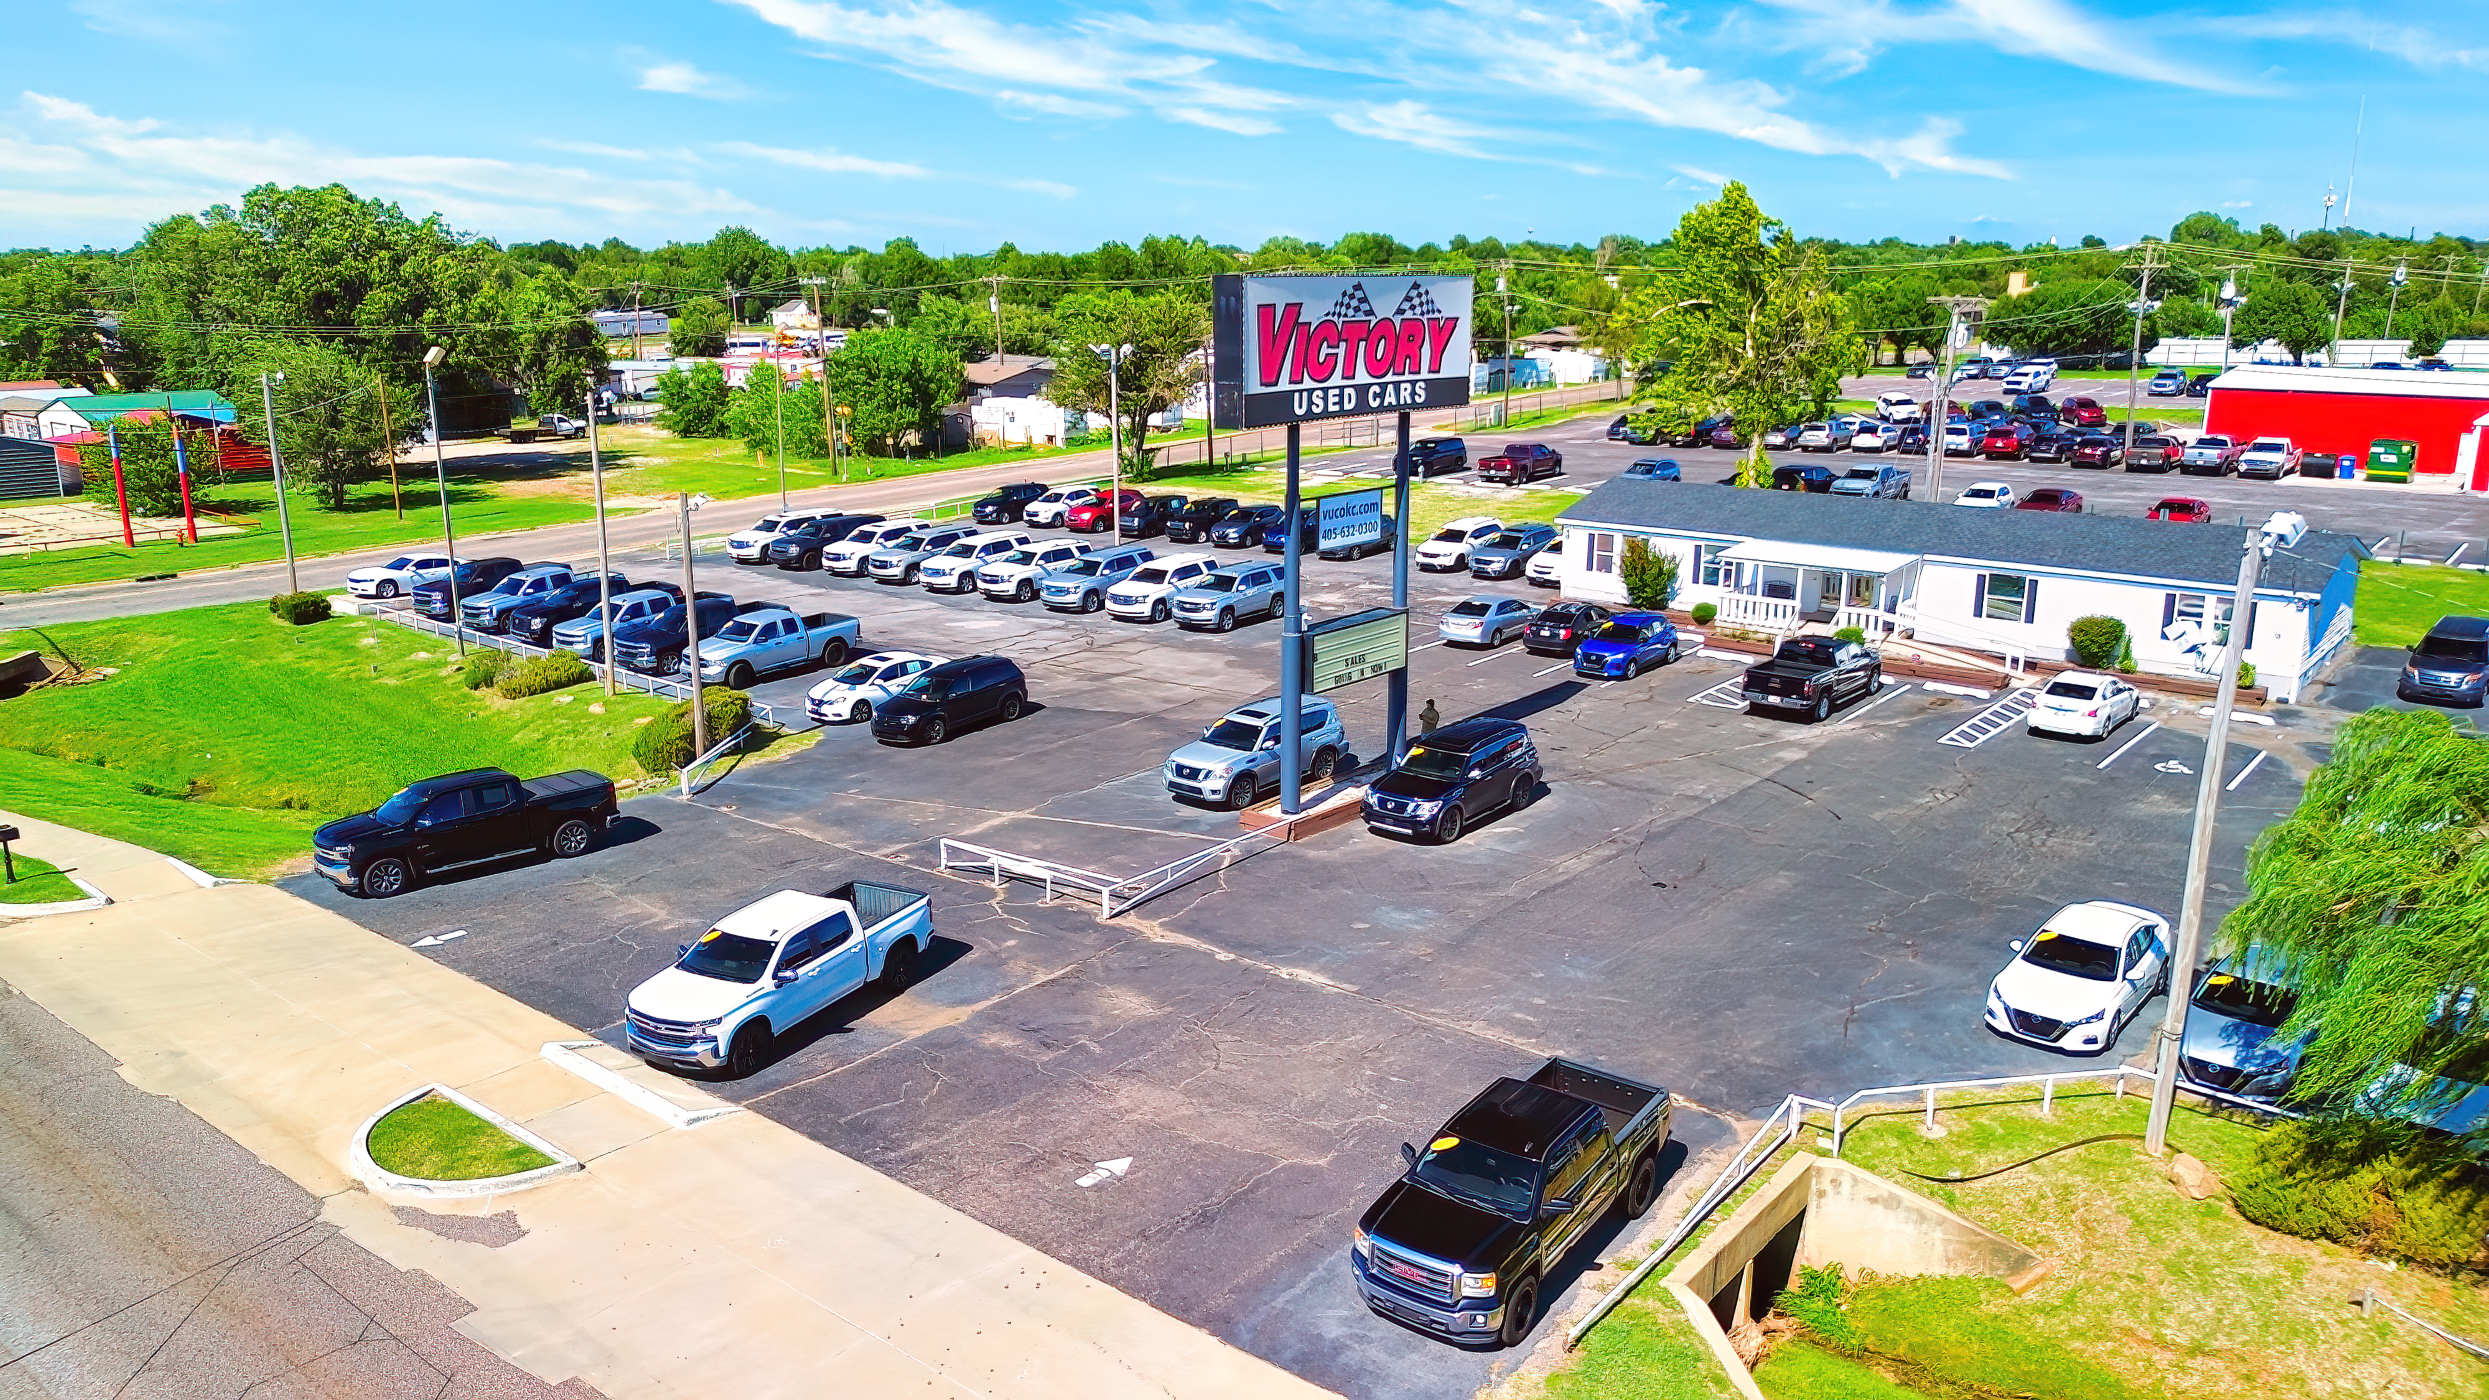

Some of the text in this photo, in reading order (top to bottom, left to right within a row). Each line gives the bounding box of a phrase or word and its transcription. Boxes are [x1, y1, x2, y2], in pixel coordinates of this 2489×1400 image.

[1257, 302, 1460, 387] VICTORY
[1293, 381, 1427, 416] USED CARS
[1321, 501, 1379, 522] vucokc.com
[1321, 520, 1379, 541] 405-632-0300
[1344, 654, 1366, 668] SALES
